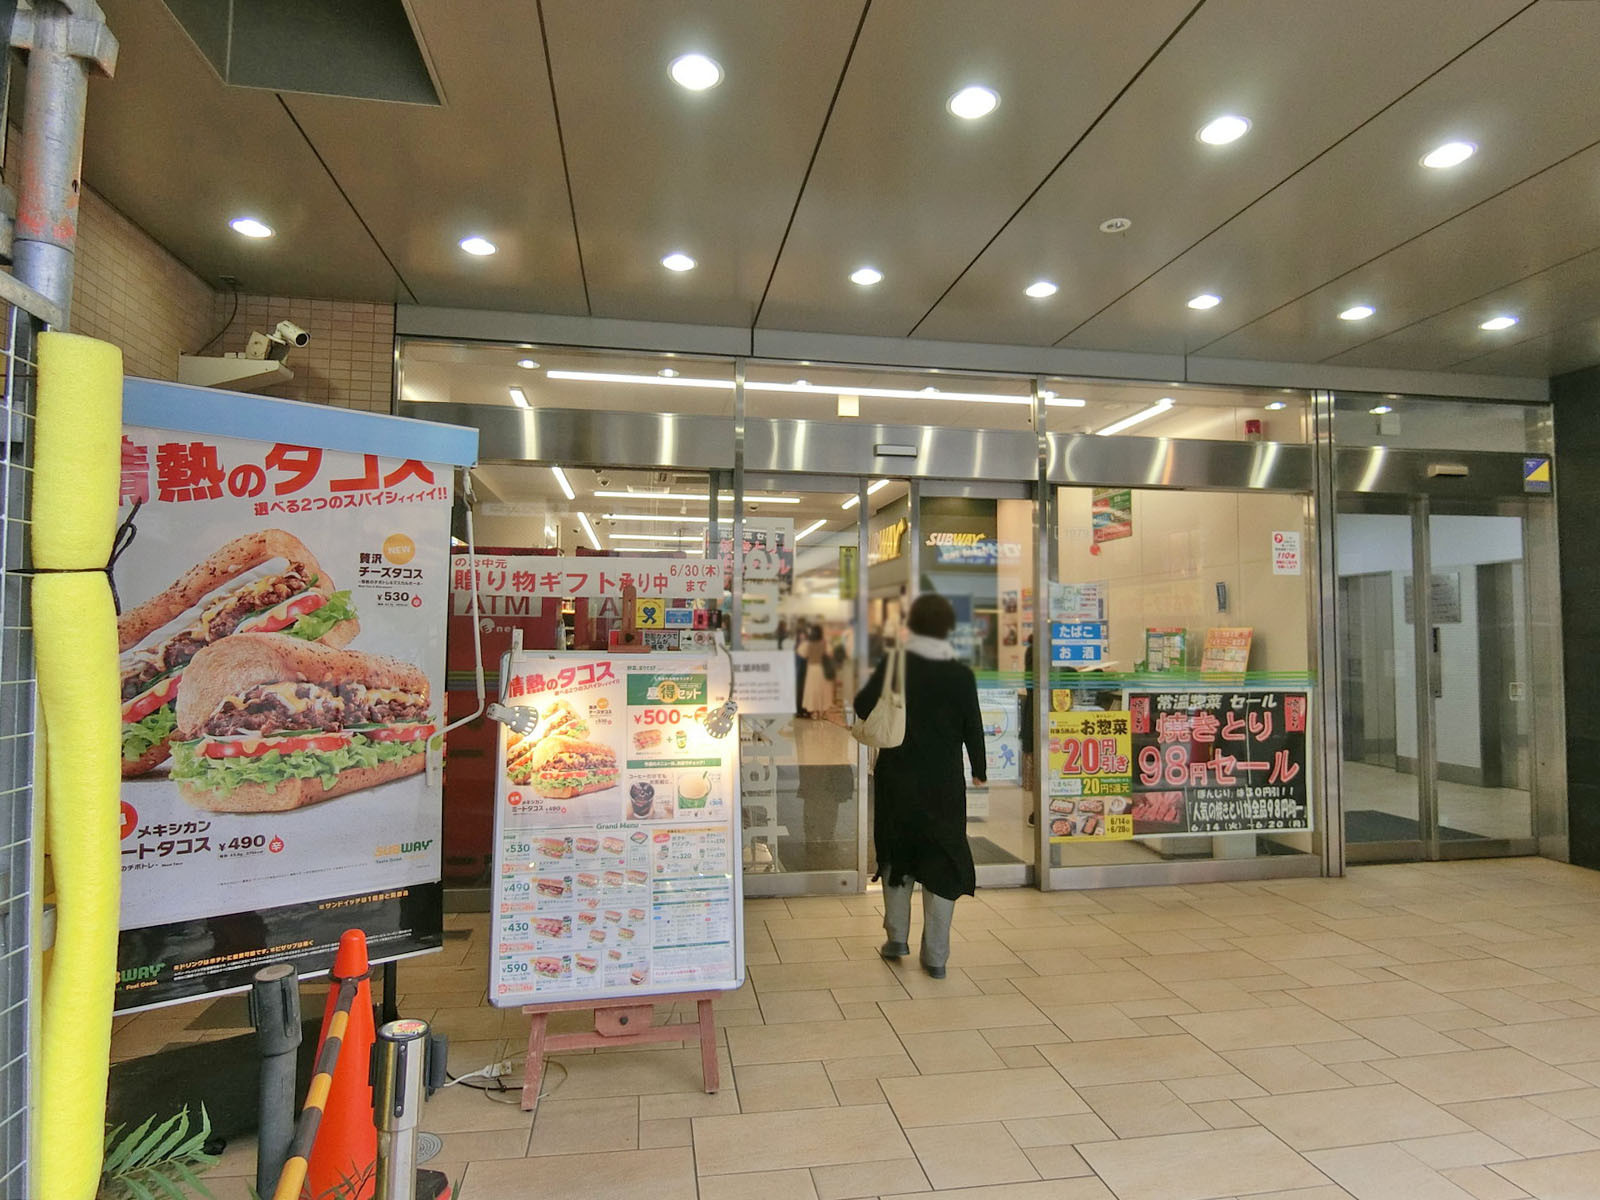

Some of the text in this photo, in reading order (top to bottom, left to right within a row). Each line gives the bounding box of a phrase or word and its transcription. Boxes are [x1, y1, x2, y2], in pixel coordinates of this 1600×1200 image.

[925, 532, 986, 547] SUBWAY
[359, 566, 424, 579] チーズタコス
[685, 580, 708, 593] まで
[377, 591, 410, 602] ¥530
[1059, 625, 1094, 638] たばこ
[508, 661, 616, 699] 情熱のタコス
[1157, 694, 1278, 710] 常温惣菜 セール
[1081, 719, 1129, 736] お惣菜
[1155, 711, 1274, 744] 焼きとり
[1138, 745, 1300, 787] 98円セール
[137, 821, 212, 839] メキシカン
[620, 821, 640, 829] Menu
[120, 836, 212, 860] ートタコス
[218, 834, 266, 852] ¥490
[374, 839, 433, 858] SUBWAY
[505, 843, 530, 853] ¥530
[504, 882, 530, 893] ¥490
[502, 922, 529, 933] ¥430
[114, 962, 167, 984] BWAY
[501, 962, 528, 974] ¥590
